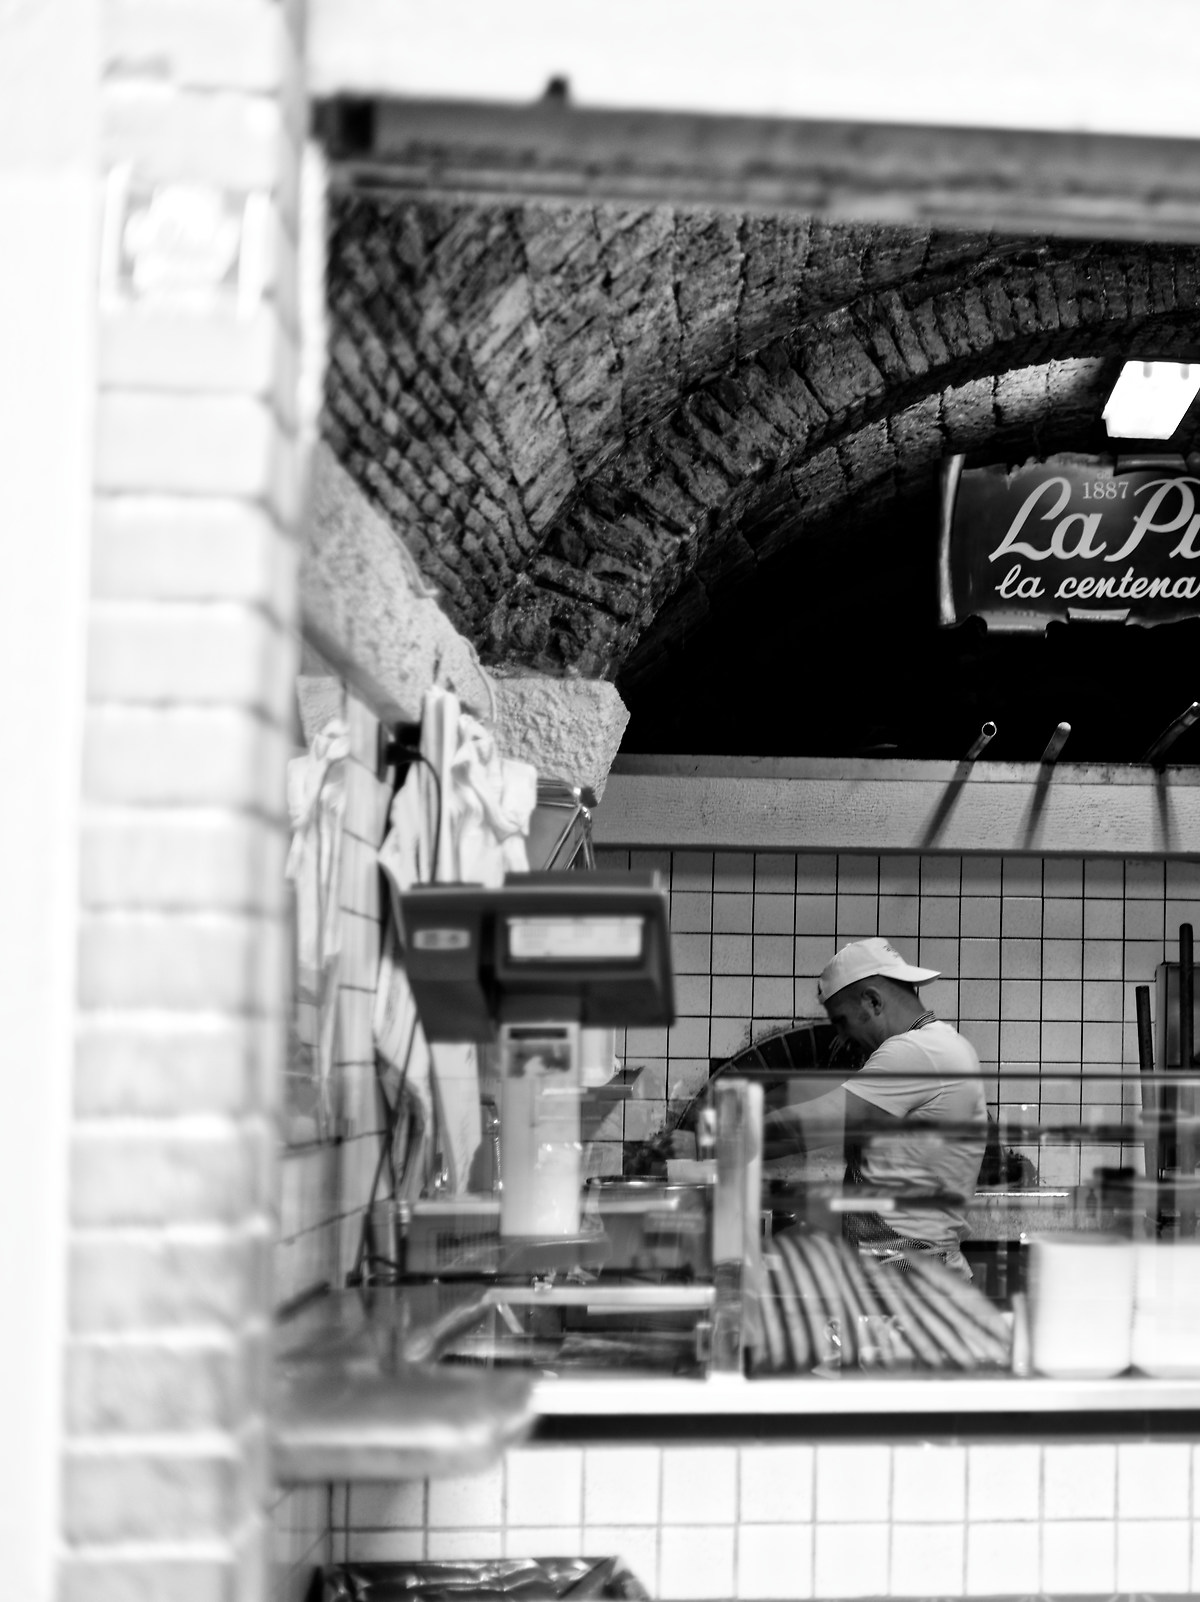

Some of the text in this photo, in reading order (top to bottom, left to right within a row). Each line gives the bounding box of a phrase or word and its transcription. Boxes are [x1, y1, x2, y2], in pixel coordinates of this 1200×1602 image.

[1082, 481, 1129, 500] 1887
[988, 476, 1107, 563] La
[995, 564, 1046, 599] la
